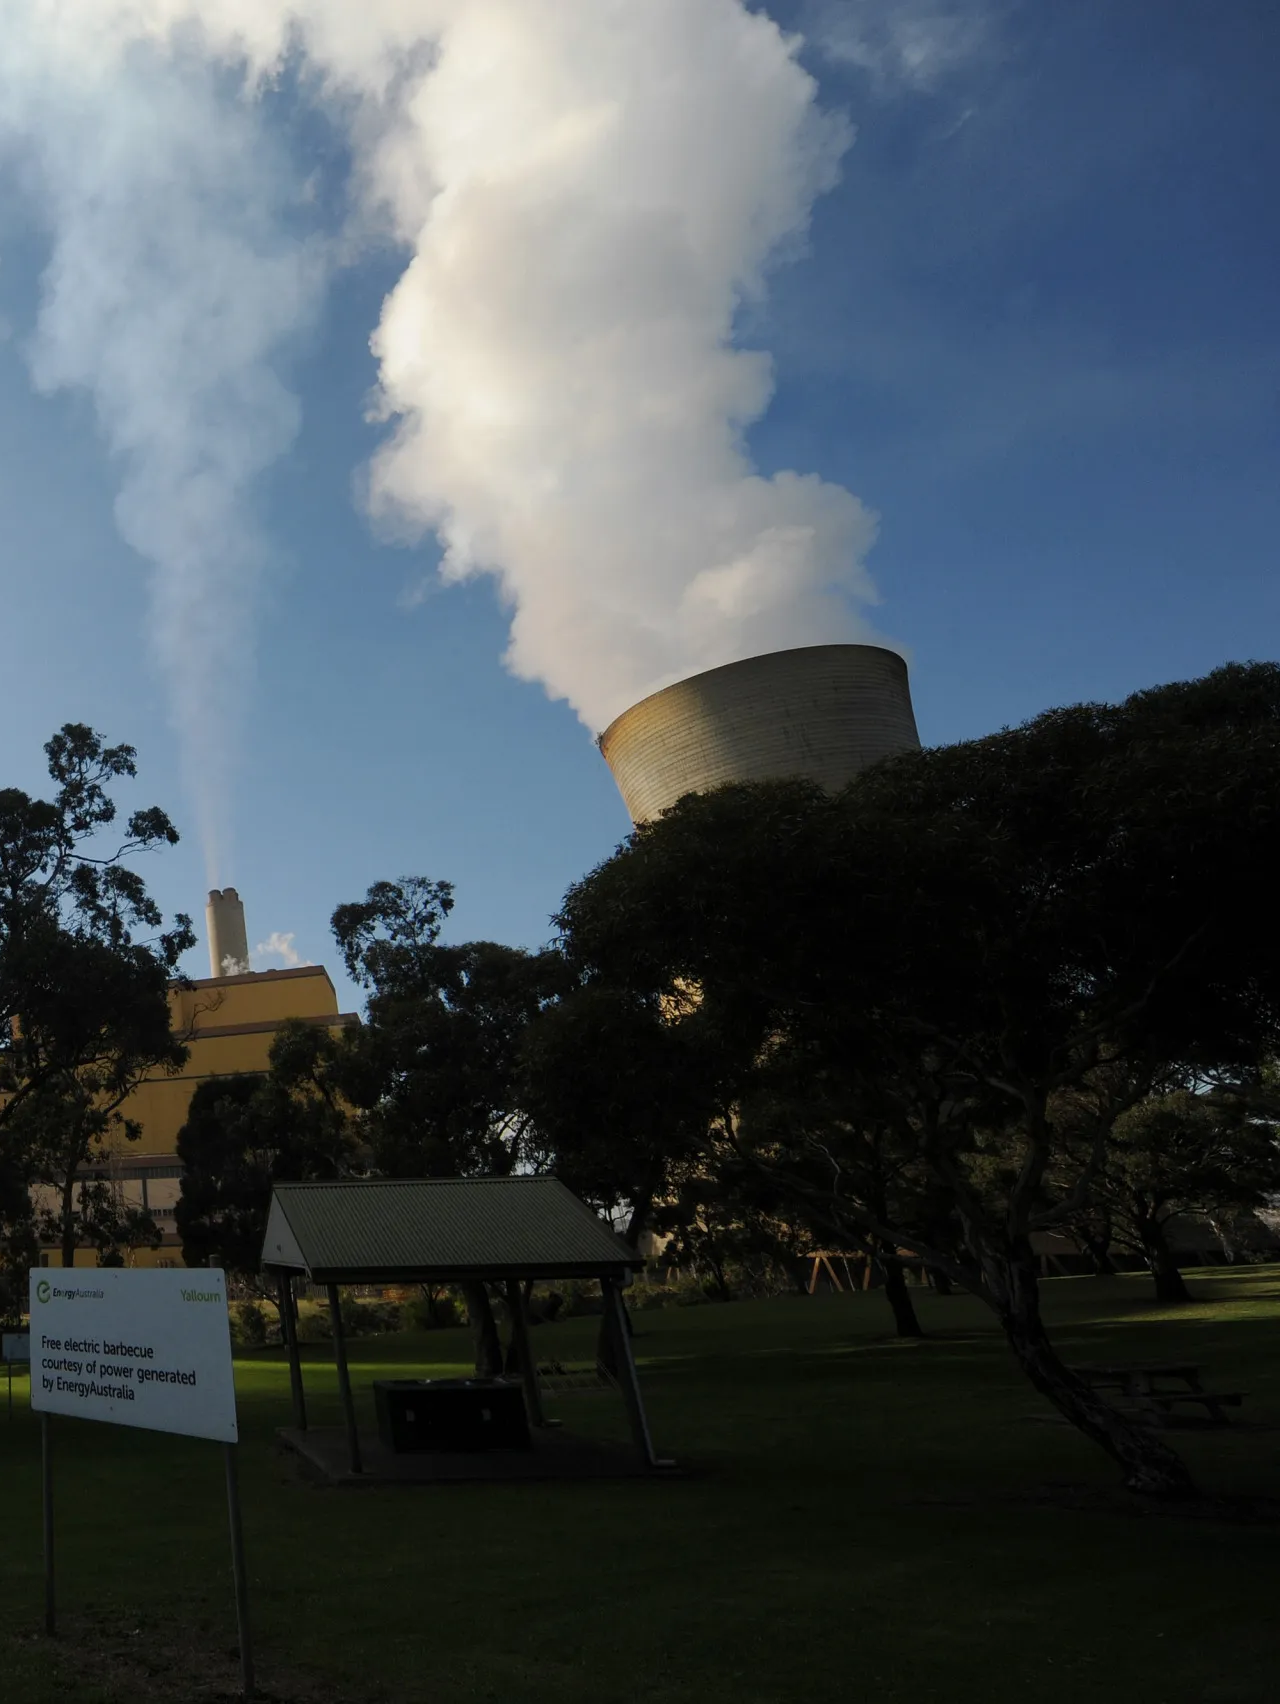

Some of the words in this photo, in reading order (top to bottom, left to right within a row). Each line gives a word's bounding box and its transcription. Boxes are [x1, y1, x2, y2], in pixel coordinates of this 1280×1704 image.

[52, 1287, 104, 1300] EnergyAustralia
[180, 1289, 220, 1302] Yallourn
[42, 1336, 61, 1350] Free
[64, 1338, 100, 1354] electric
[104, 1341, 154, 1359] barbecue
[42, 1357, 83, 1376] courtesy
[86, 1360, 97, 1374] of
[100, 1364, 134, 1378] power
[137, 1370, 196, 1386] generated
[42, 1375, 55, 1392] by
[57, 1377, 135, 1400] EnergyAustralia
